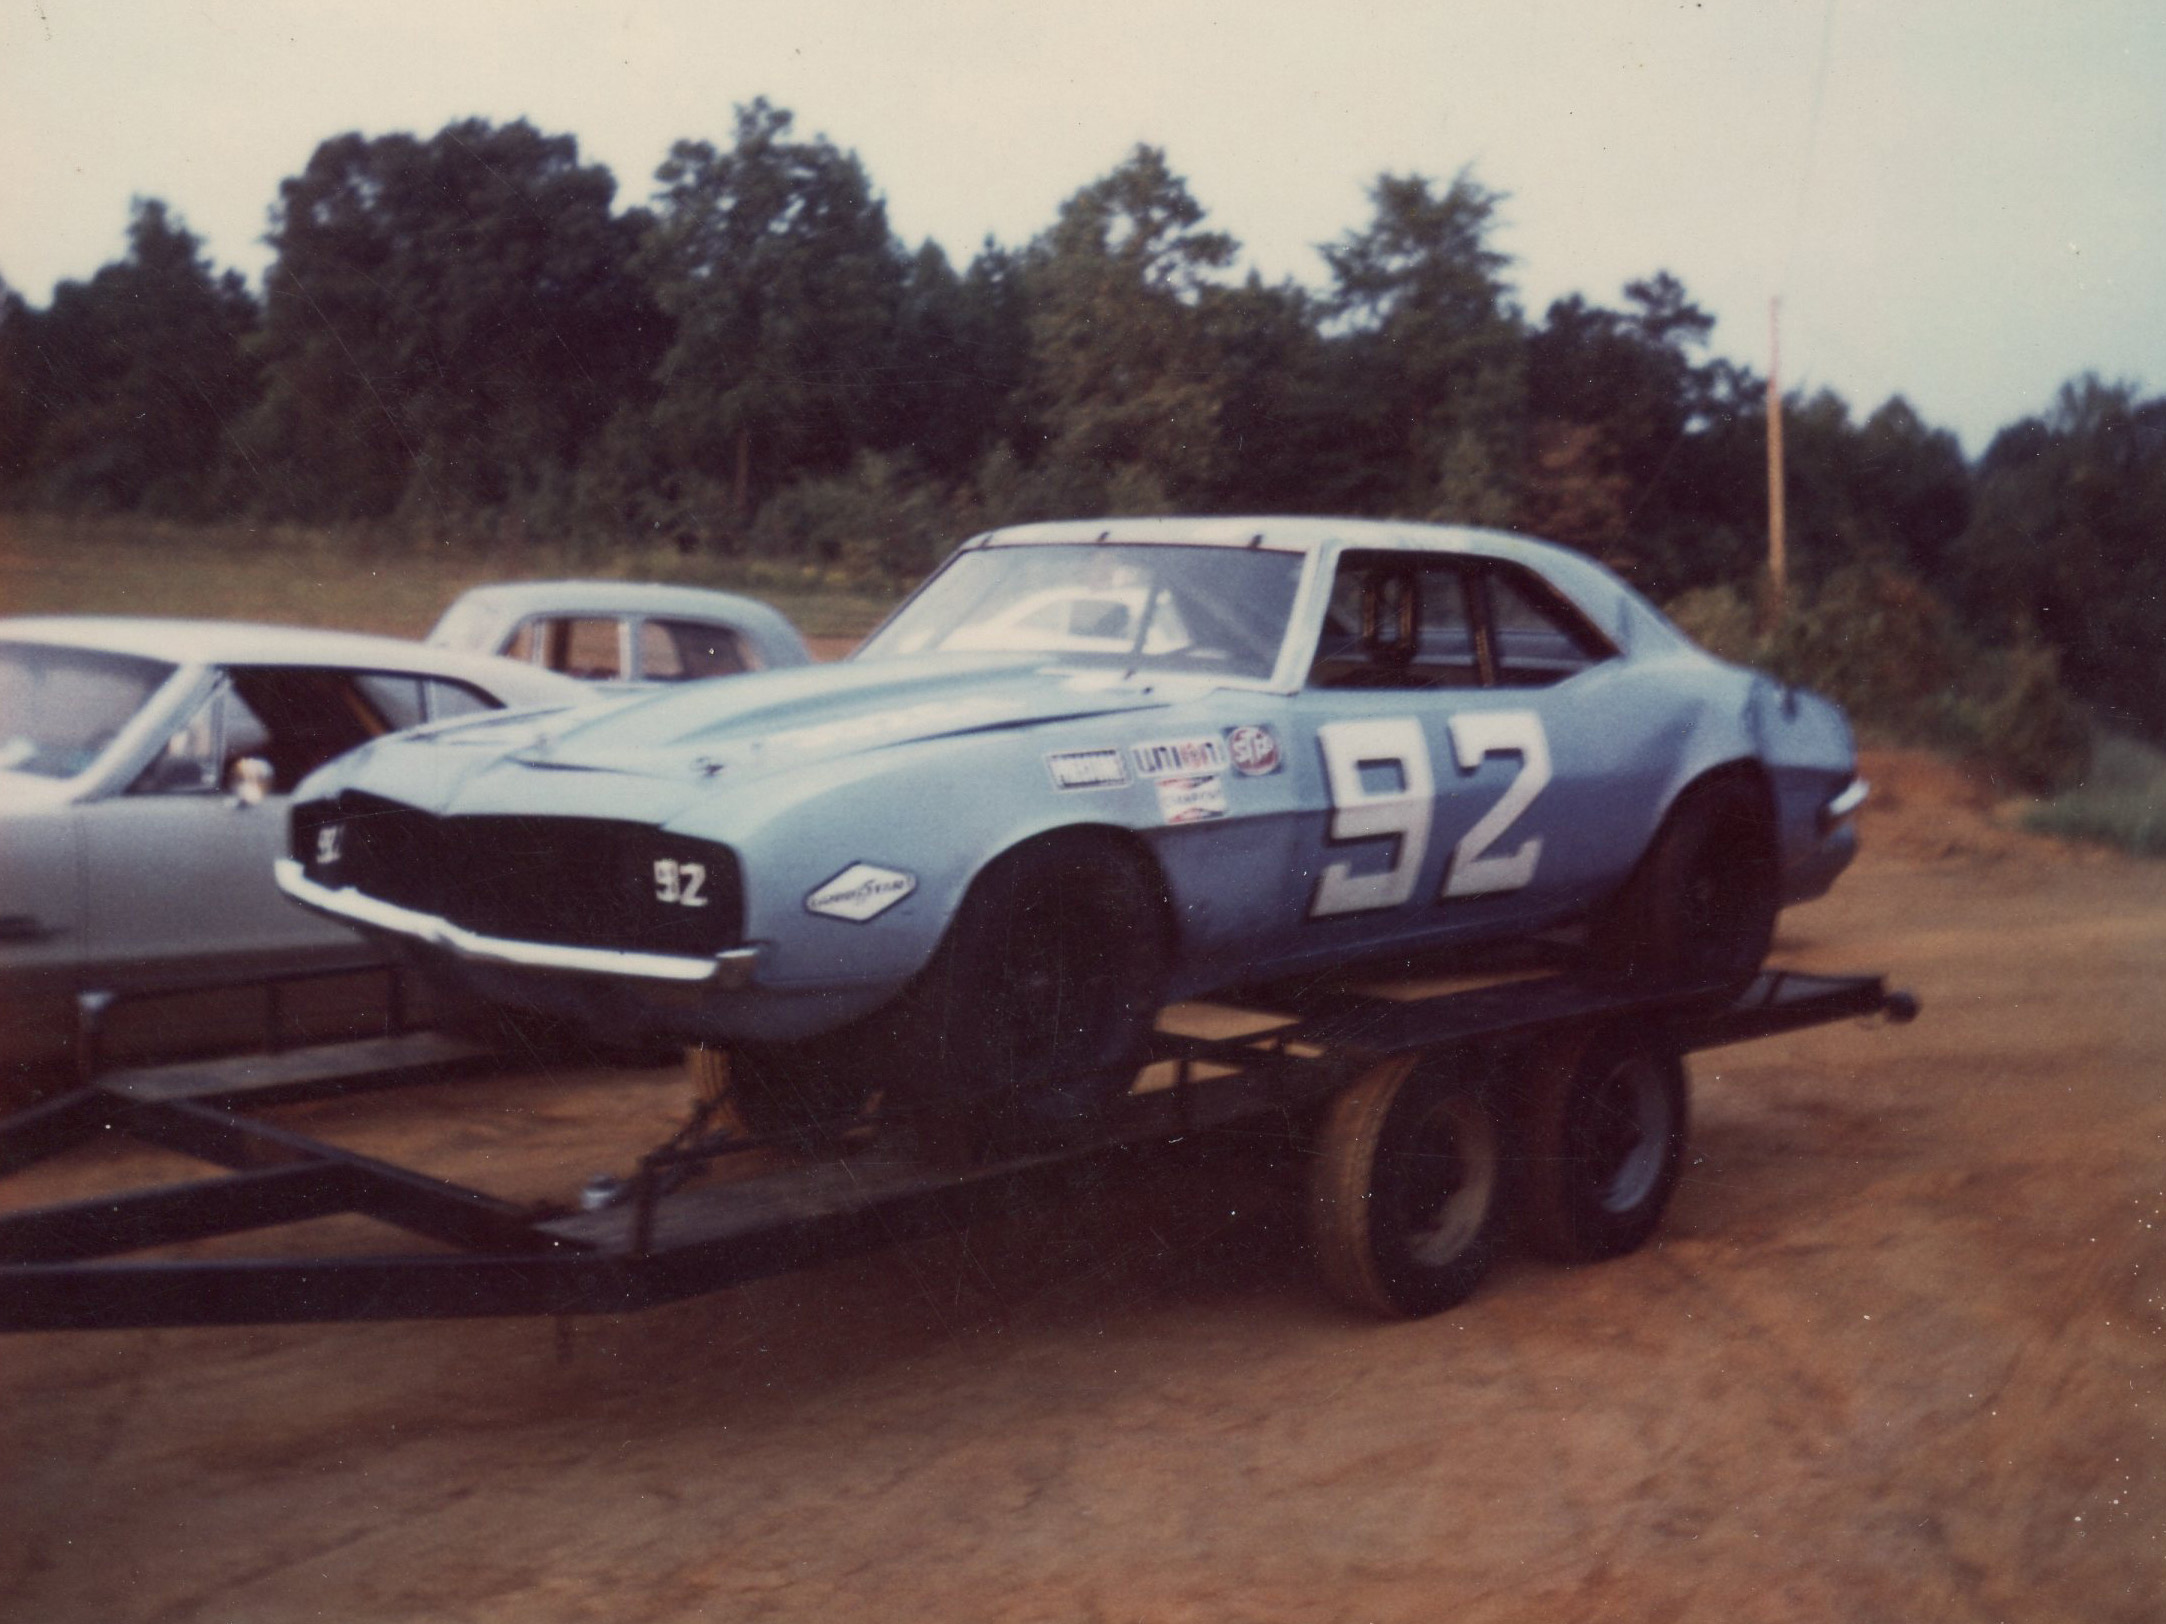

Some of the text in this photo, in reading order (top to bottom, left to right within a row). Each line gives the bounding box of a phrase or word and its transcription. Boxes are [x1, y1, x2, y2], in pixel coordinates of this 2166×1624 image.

[1230, 728, 1276, 767] STP
[1309, 709, 1552, 917] 92
[654, 858, 708, 906] 92
